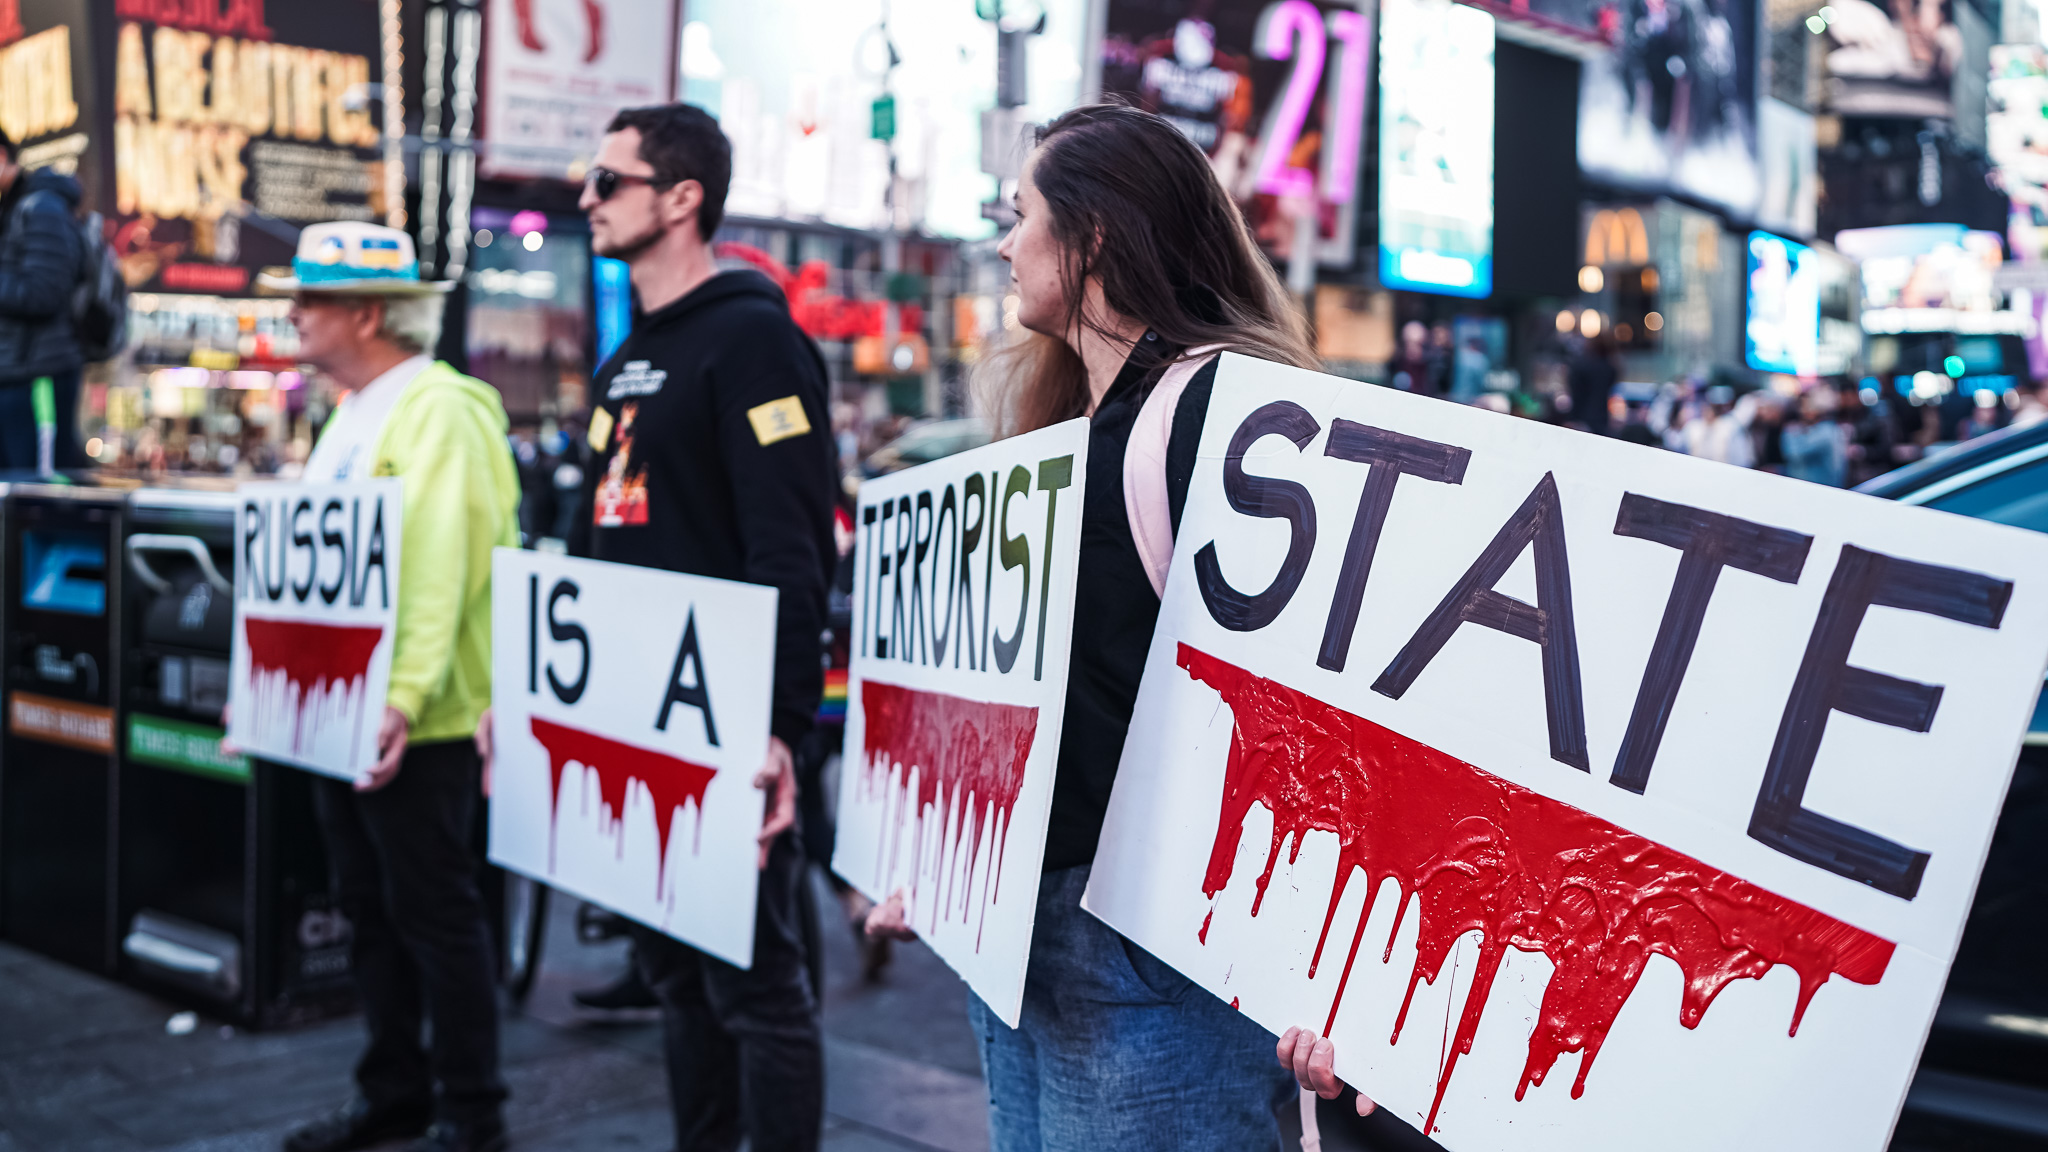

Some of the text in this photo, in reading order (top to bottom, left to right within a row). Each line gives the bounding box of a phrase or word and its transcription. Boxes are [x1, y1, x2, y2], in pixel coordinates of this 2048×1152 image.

[245, 495, 389, 609] RUSSIA
[861, 453, 1074, 681] TERRORIST
[1194, 400, 2014, 901] STATE
[528, 573, 721, 748] IS A
